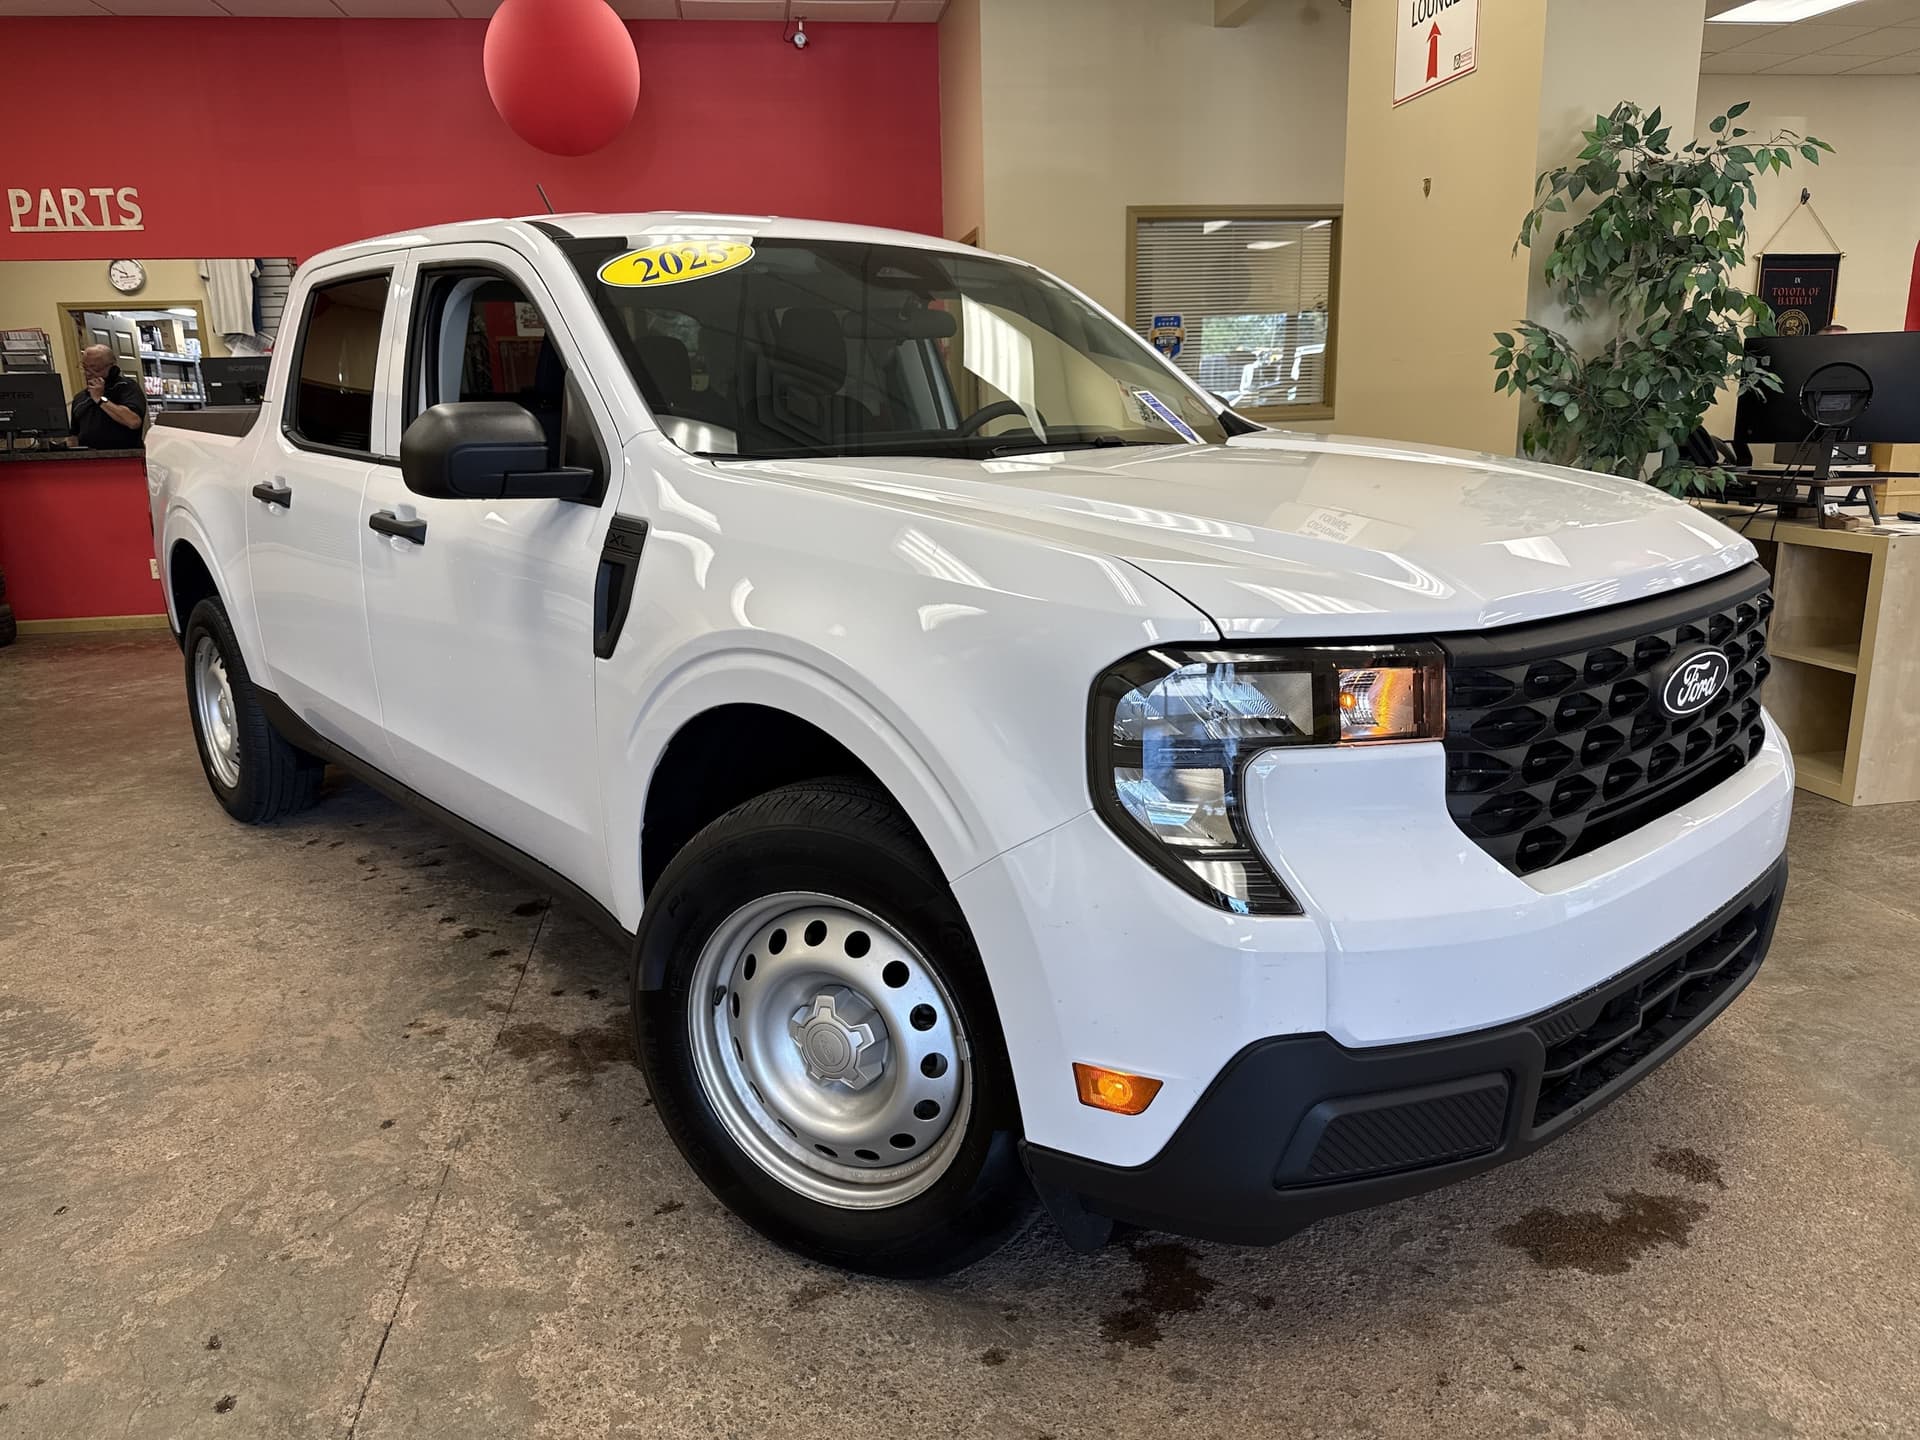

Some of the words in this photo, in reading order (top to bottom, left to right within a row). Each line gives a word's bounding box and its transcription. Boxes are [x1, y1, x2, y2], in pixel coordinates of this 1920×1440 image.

[1411, 0, 1460, 27] LOUN
[7, 186, 144, 229] PARTS
[632, 242, 729, 283] 2025
[1771, 287, 1806, 297] TOYOTA
[1808, 287, 1821, 297] OF
[1777, 296, 1813, 305] BATAVIA
[608, 532, 633, 550] XL
[1677, 661, 1720, 706] Ford
